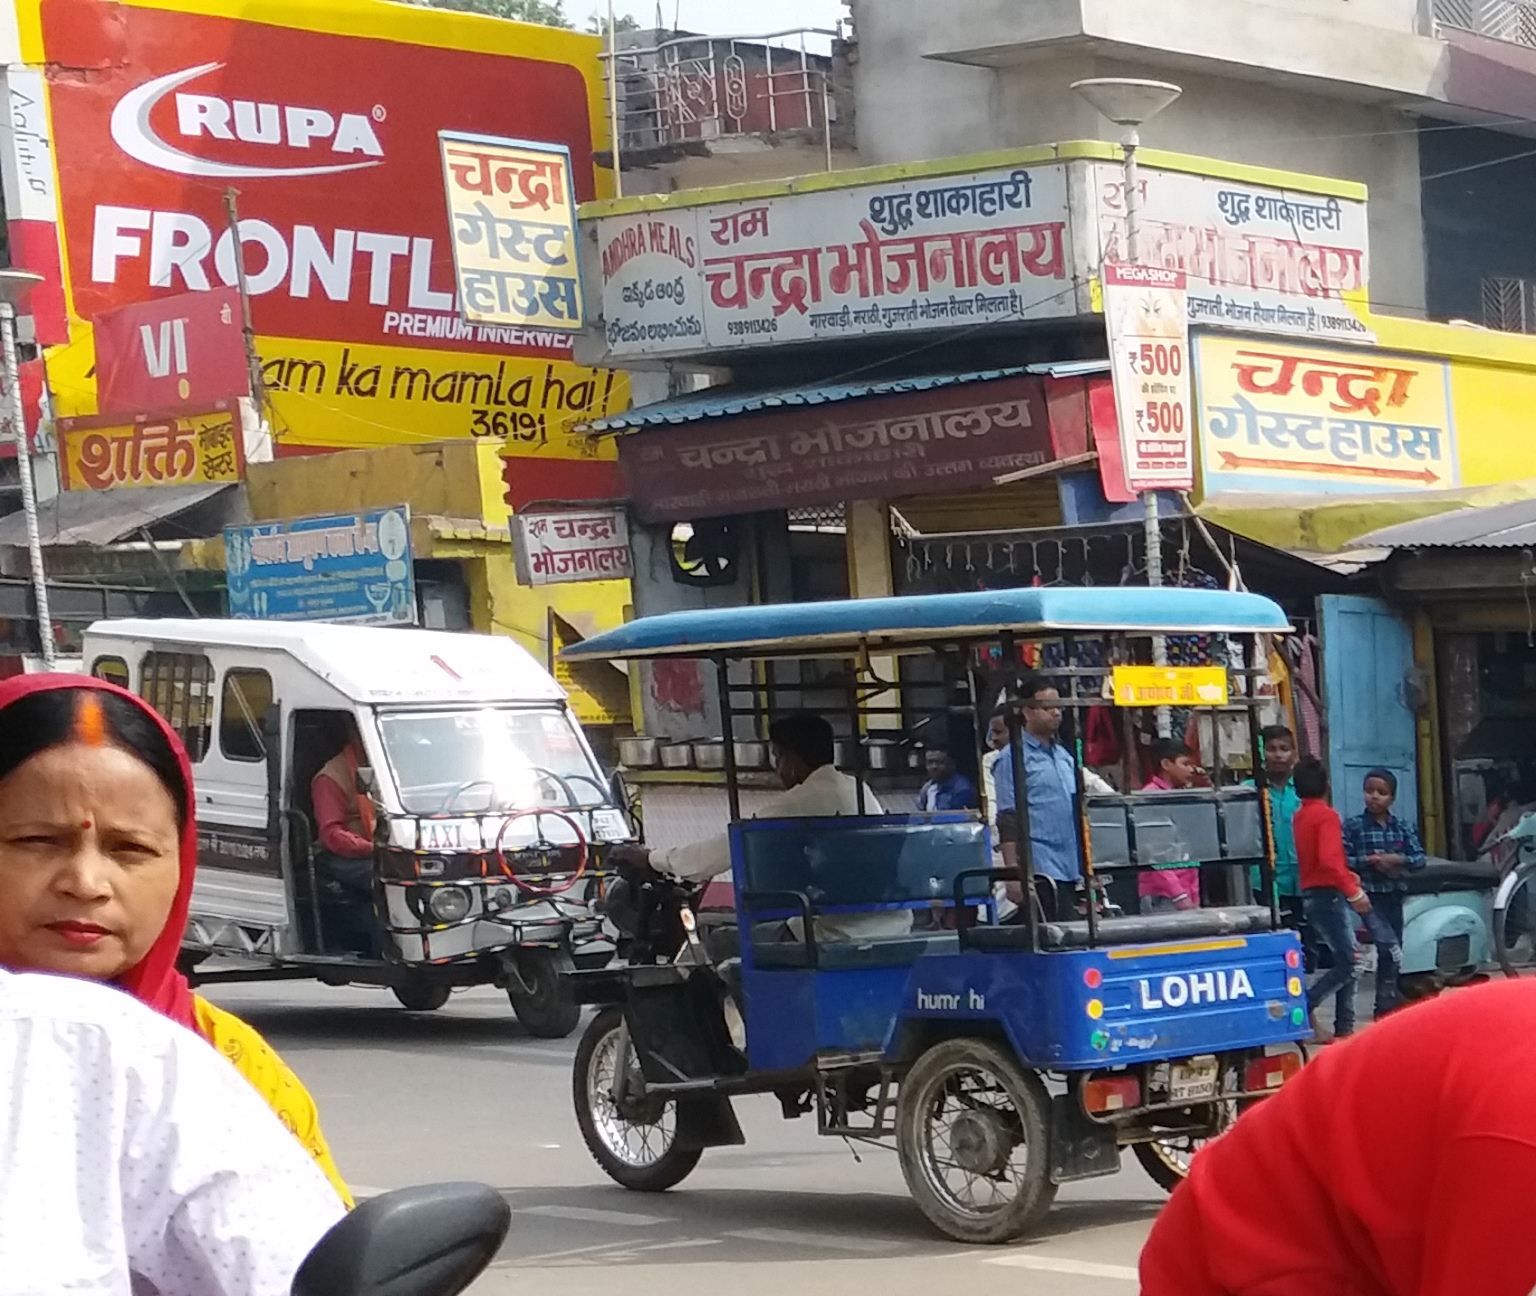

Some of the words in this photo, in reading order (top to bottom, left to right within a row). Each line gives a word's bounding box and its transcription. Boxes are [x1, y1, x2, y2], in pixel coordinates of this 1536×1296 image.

[176, 93, 384, 157] RUPA
[447, 149, 564, 212] चन्द्रा
[710, 207, 770, 247] राम
[916, 170, 1033, 219] शाकाहारी
[454, 200, 570, 266] गेस्ट
[1255, 195, 1342, 231] शाकाहारी
[92, 205, 460, 310] FRONTL
[602, 223, 646, 285] ANDHRA
[647, 221, 696, 269] MEALS
[703, 247, 823, 318] चन्द्रा
[826, 218, 1066, 299] भोजनालय
[1115, 266, 1178, 284] MEGASHOP
[460, 267, 580, 321] हाउस
[974, 294, 1009, 314] मिलता
[383, 312, 472, 340] PREMIUM
[336, 348, 379, 398] ka
[391, 361, 533, 408] mamla
[1230, 350, 1419, 417] चन्द्रा
[470, 409, 548, 442] 36191
[676, 435, 784, 471] चन्द्रा
[789, 399, 1034, 457] भोजनालय
[1206, 393, 1326, 451] गेस्ट
[1326, 417, 1442, 462] हाउस
[531, 543, 632, 575] भोजनालय
[552, 516, 617, 541] चन्द्रा
[1139, 968, 1255, 1010] LOHIA
